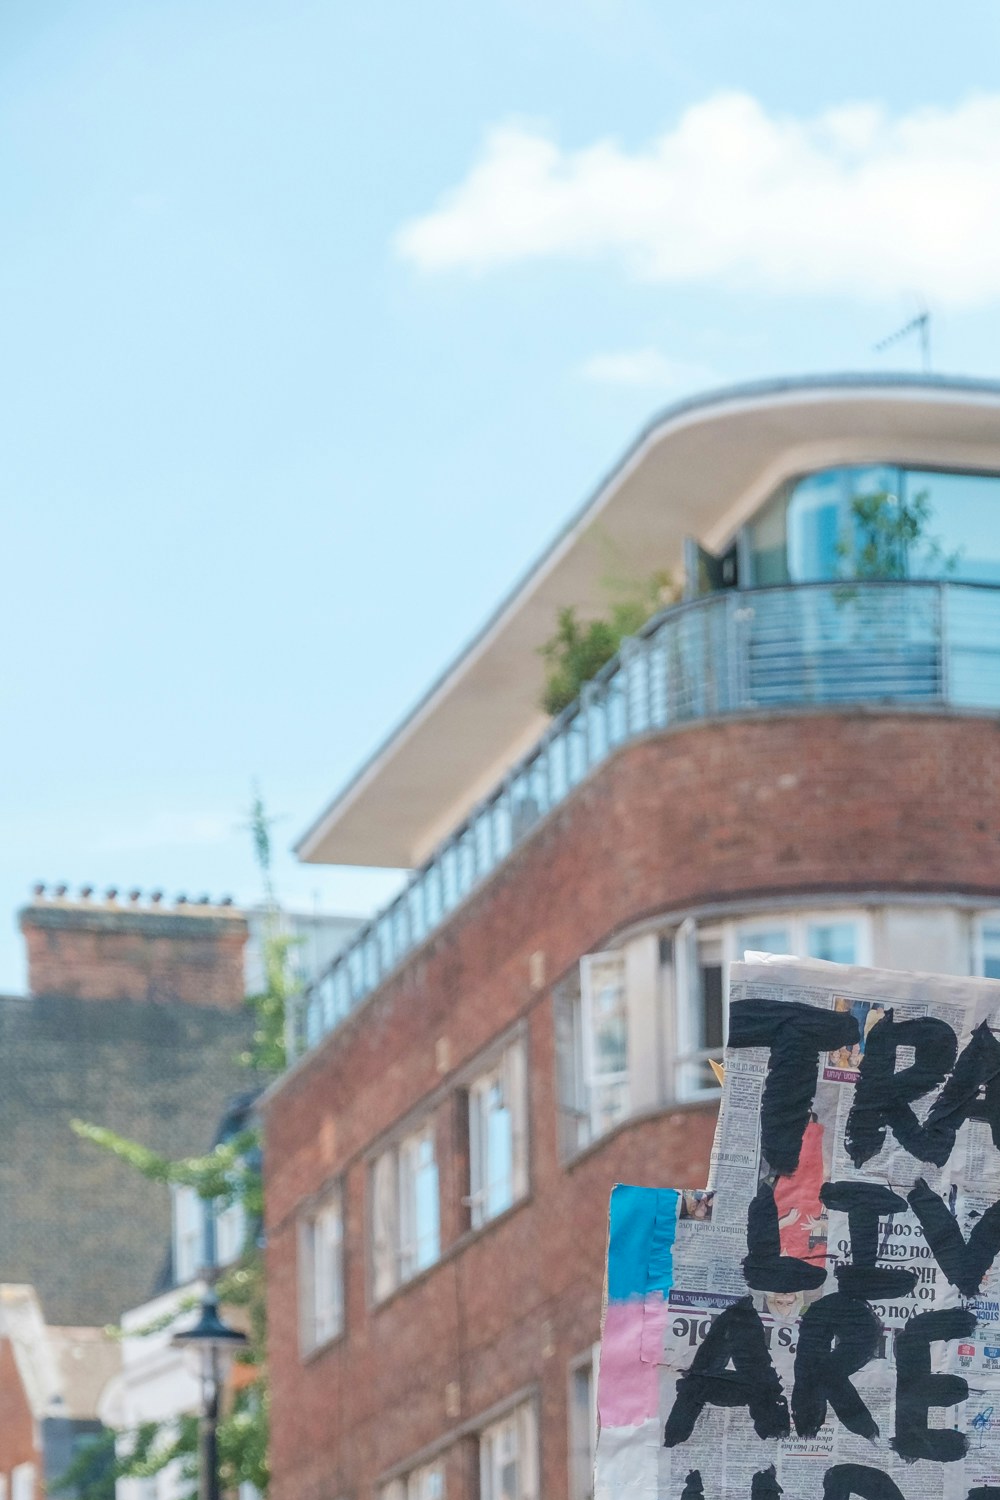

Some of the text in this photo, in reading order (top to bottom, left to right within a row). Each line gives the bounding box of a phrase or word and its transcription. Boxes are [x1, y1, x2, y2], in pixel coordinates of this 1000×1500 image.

[679, 1221, 694, 1232] love
[919, 1287, 936, 1302] to
[888, 1303, 918, 1319] you
[665, 1293, 981, 1462] ARE
